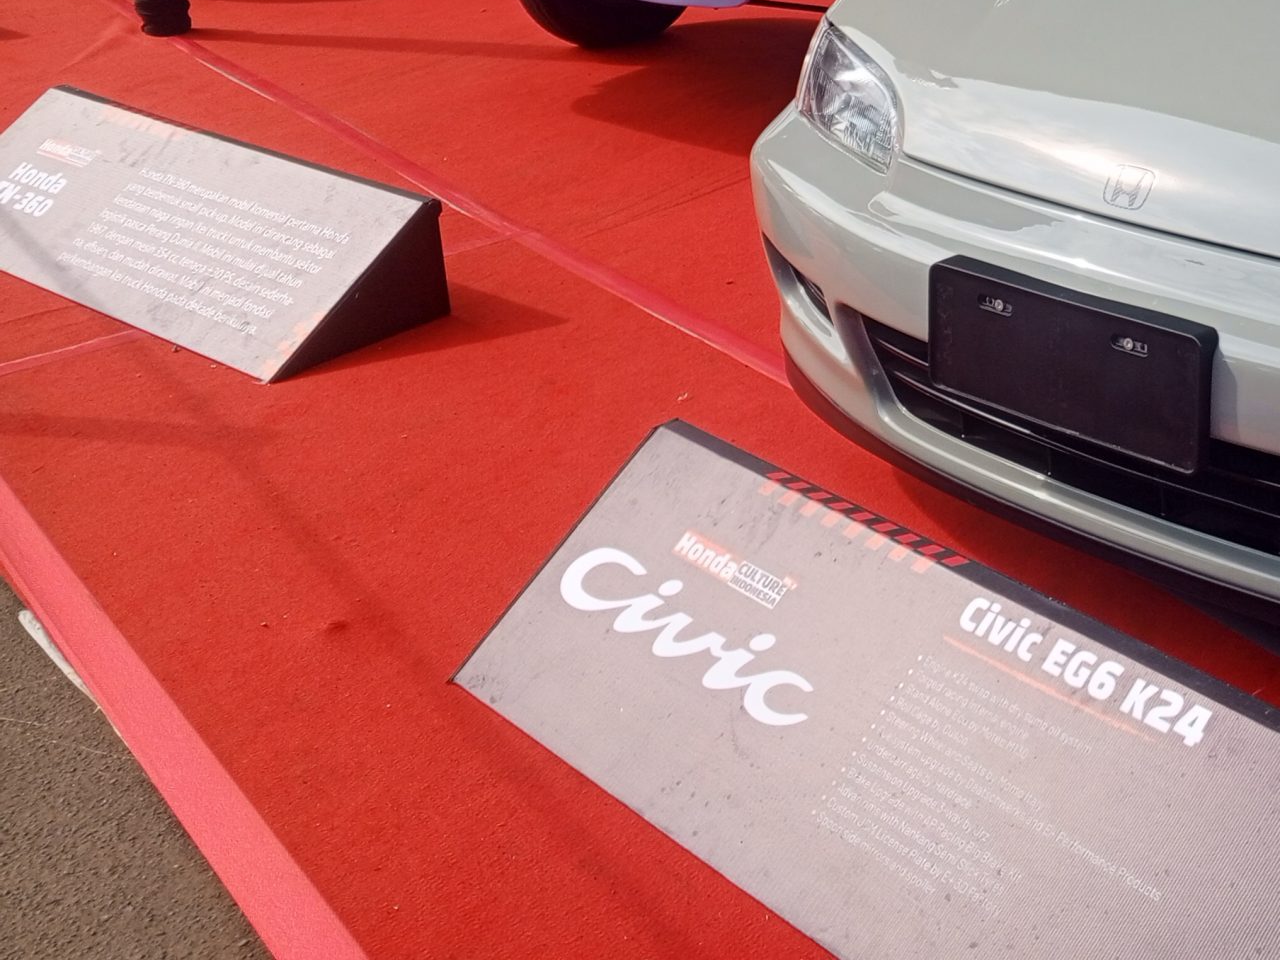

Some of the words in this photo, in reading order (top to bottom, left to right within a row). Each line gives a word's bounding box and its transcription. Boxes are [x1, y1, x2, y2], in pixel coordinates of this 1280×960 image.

[8, 161, 67, 194] Honda
[183, 181, 232, 206] merupakan
[225, 194, 255, 211] mobil
[283, 215, 325, 237] pertama
[317, 225, 354, 245] Honda
[225, 213, 258, 231] Model
[250, 222, 268, 235] ini
[140, 222, 175, 243] Perang
[167, 231, 197, 249] Dunia
[197, 242, 227, 259] Mobil
[219, 251, 237, 263] ini
[229, 254, 259, 271] mulai
[274, 270, 306, 289] tahun
[226, 233, 257, 250] untuk
[249, 241, 299, 266] membantu
[291, 256, 325, 275] sektor
[258, 226, 307, 251] dirancang
[297, 239, 339, 262] sebagai
[105, 248, 128, 263] dan
[120, 252, 154, 272] mudah
[205, 286, 247, 310] menjadi
[238, 298, 277, 320] fondasi
[151, 245, 173, 260] 354
[174, 254, 210, 276] tenaga
[230, 275, 264, 294] desain
[138, 279, 171, 299] Honda
[161, 290, 190, 309] pada
[182, 297, 219, 319] dekade
[673, 530, 738, 580] Honda
[730, 576, 777, 607] INDONESIA
[738, 562, 788, 597] CULTURE
[560, 547, 814, 726] Civic
[959, 597, 1043, 662] Civic
[1041, 638, 1125, 701] EG6
[1119, 678, 1213, 747] K24
[898, 780, 940, 812] Upgrade
[824, 795, 861, 824] Custom
[873, 826, 912, 857] License
[905, 847, 934, 872] Plate
[926, 862, 945, 881] by
[877, 807, 902, 829] with
[894, 819, 938, 854] Nankang
[932, 821, 968, 852] Racing
[1054, 829, 1119, 876] Performance
[1114, 865, 1165, 903] Products
